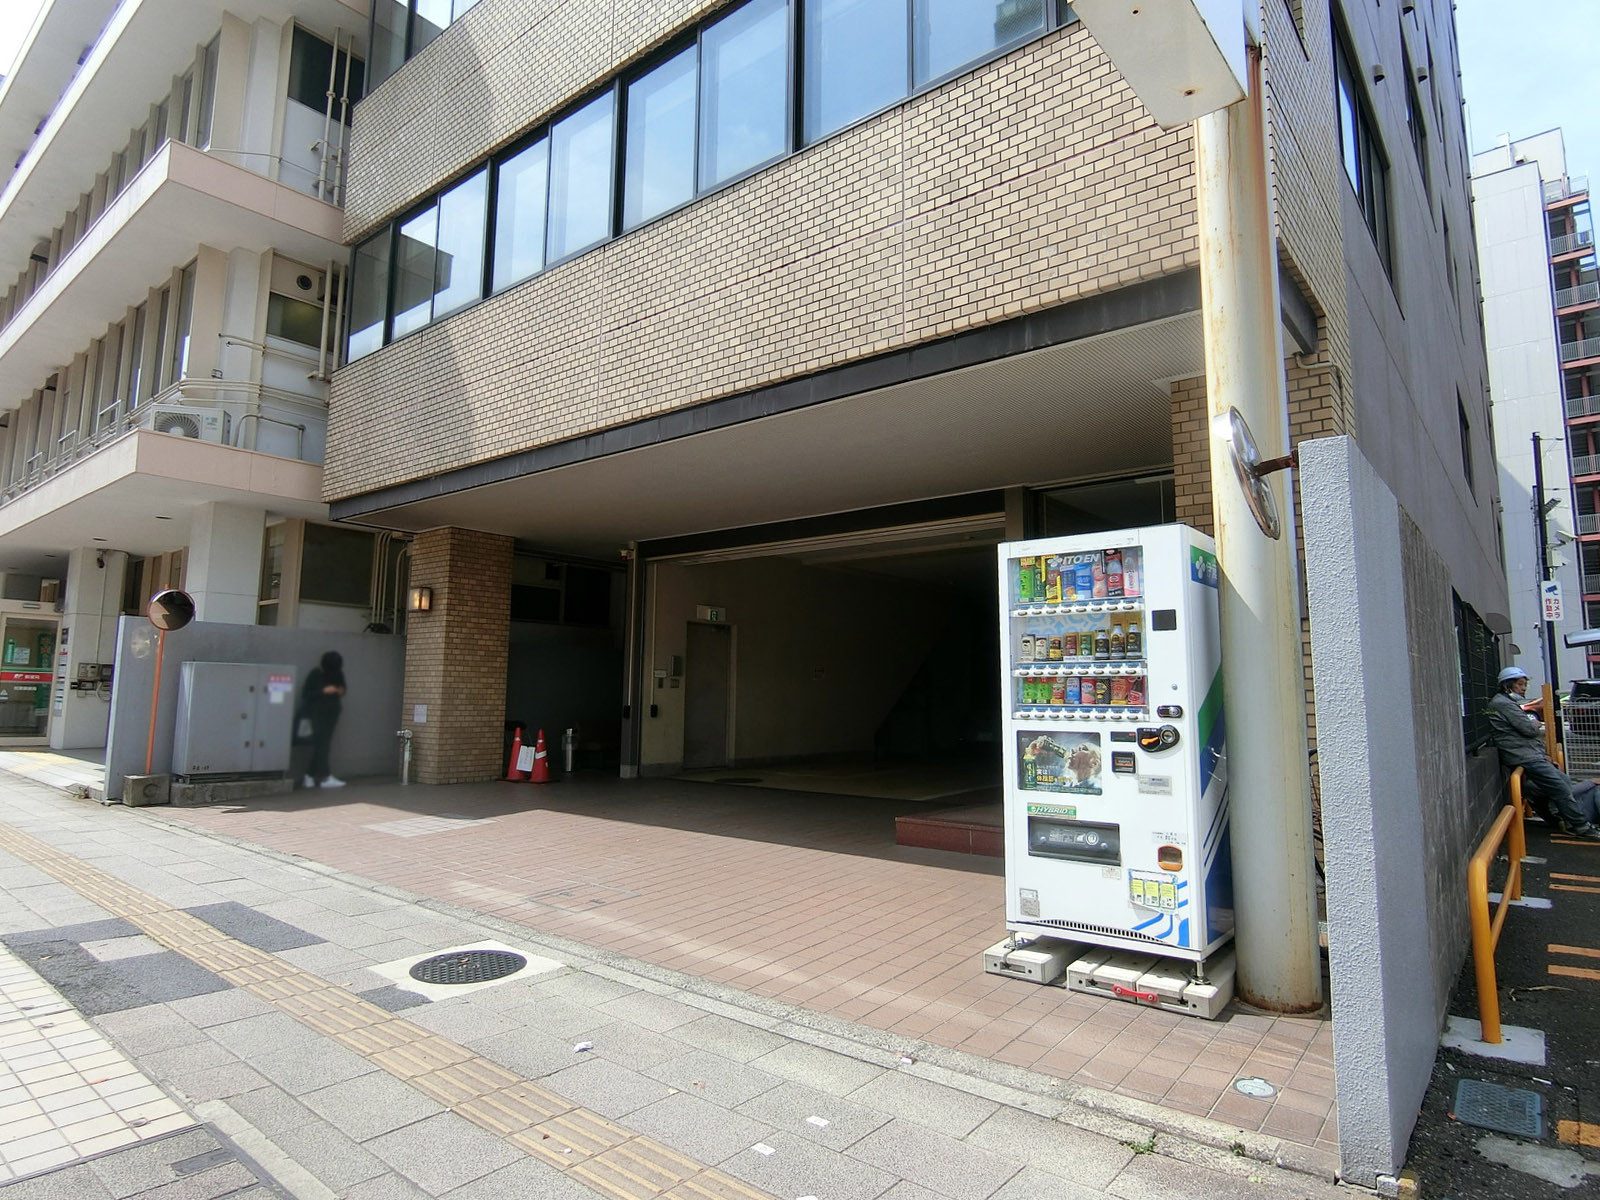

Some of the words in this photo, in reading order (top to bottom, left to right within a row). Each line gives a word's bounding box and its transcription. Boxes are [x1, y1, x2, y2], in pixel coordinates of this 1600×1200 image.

[1062, 555, 1083, 565] ITO
[1083, 553, 1101, 563] EN
[1545, 598, 1553, 619] 作動中
[1553, 598, 1561, 619] カメラ
[1036, 806, 1068, 815] HYBRID
